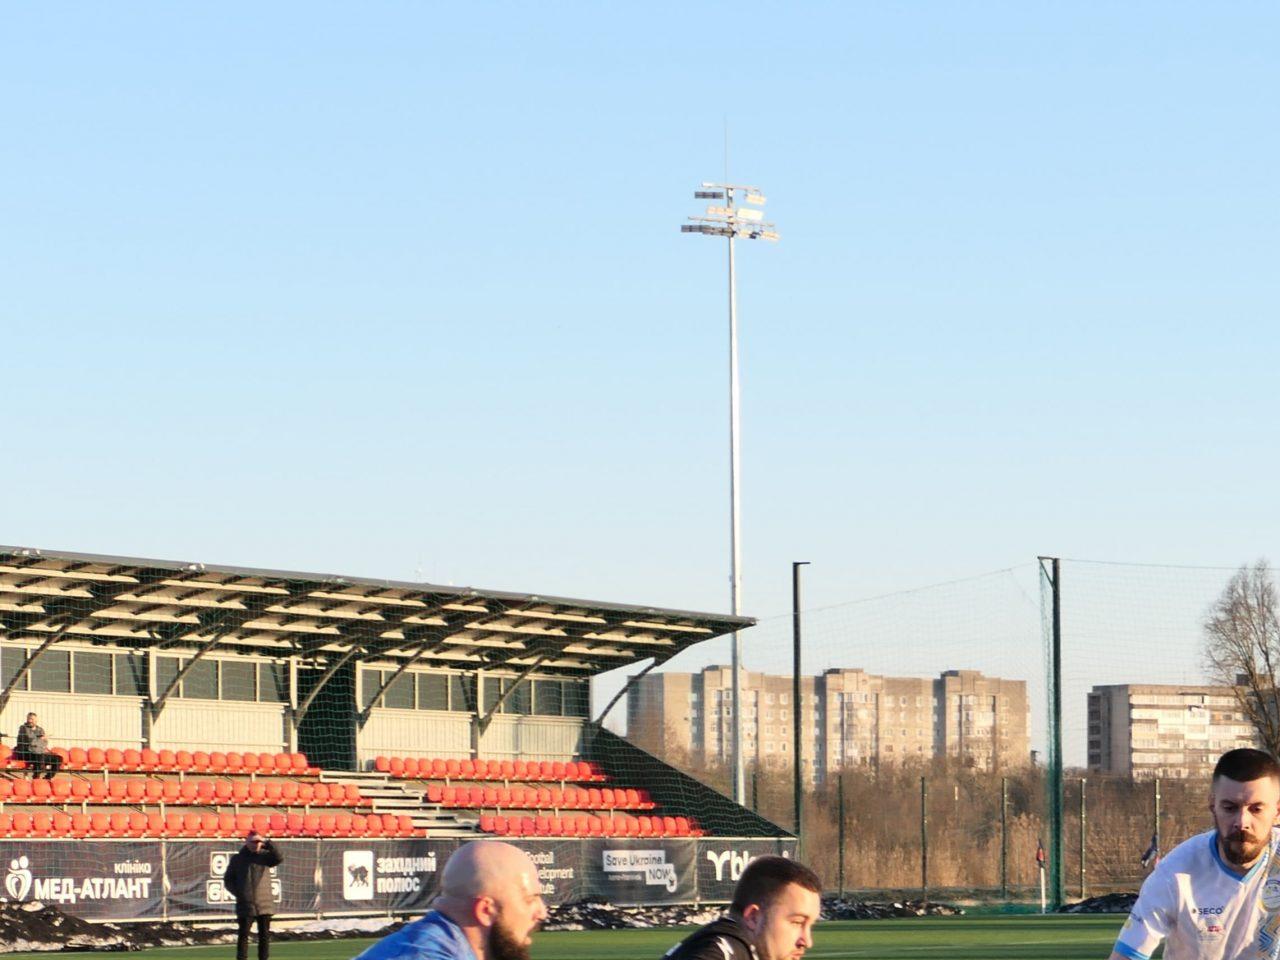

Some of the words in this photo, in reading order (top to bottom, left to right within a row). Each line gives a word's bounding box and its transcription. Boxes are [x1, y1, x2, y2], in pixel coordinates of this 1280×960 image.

[606, 854, 628, 867] Save
[629, 853, 663, 866] Ukraine
[34, 877, 152, 904] МЕД-АТЛАНТ
[1198, 907, 1223, 915] SECO
